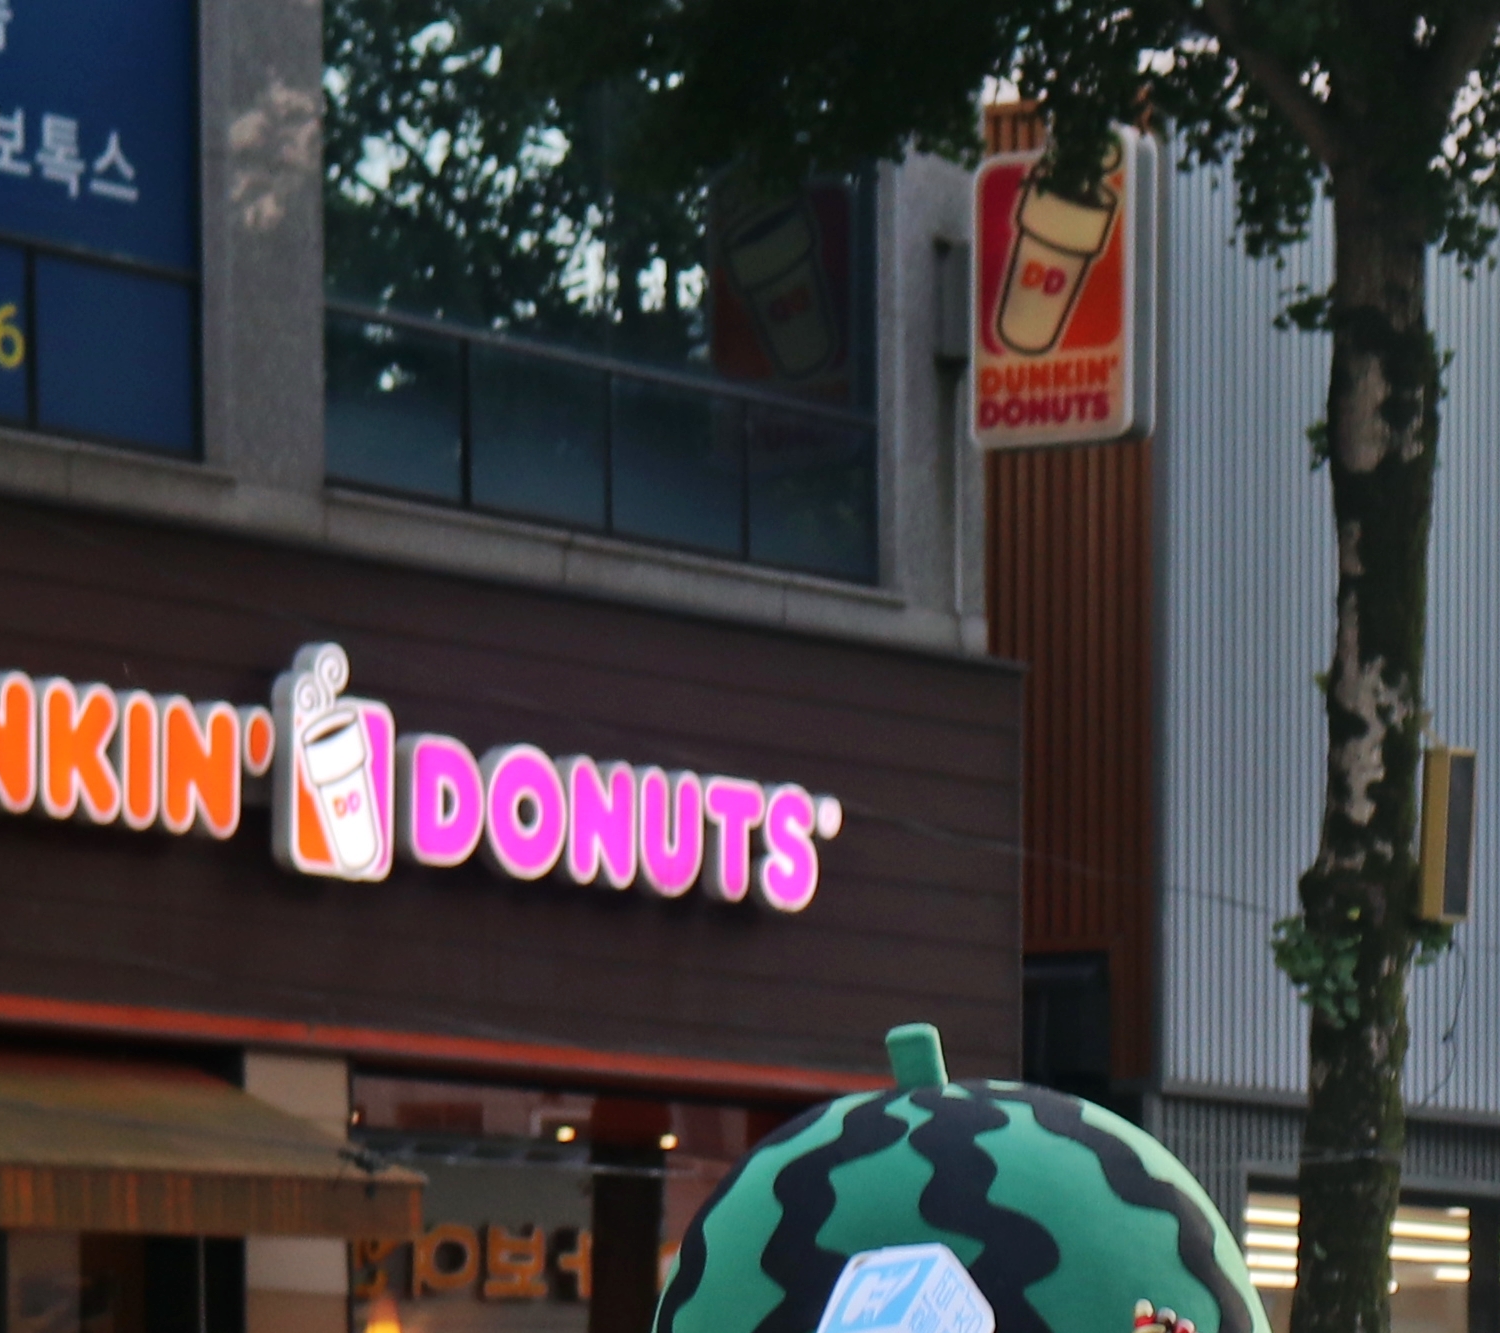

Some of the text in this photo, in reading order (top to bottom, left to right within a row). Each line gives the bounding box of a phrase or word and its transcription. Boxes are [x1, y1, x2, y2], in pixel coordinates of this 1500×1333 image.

[980, 354, 1119, 397] DUNKIN'
[978, 391, 1110, 431] DONUTS
[410, 733, 820, 912] DONUTS
